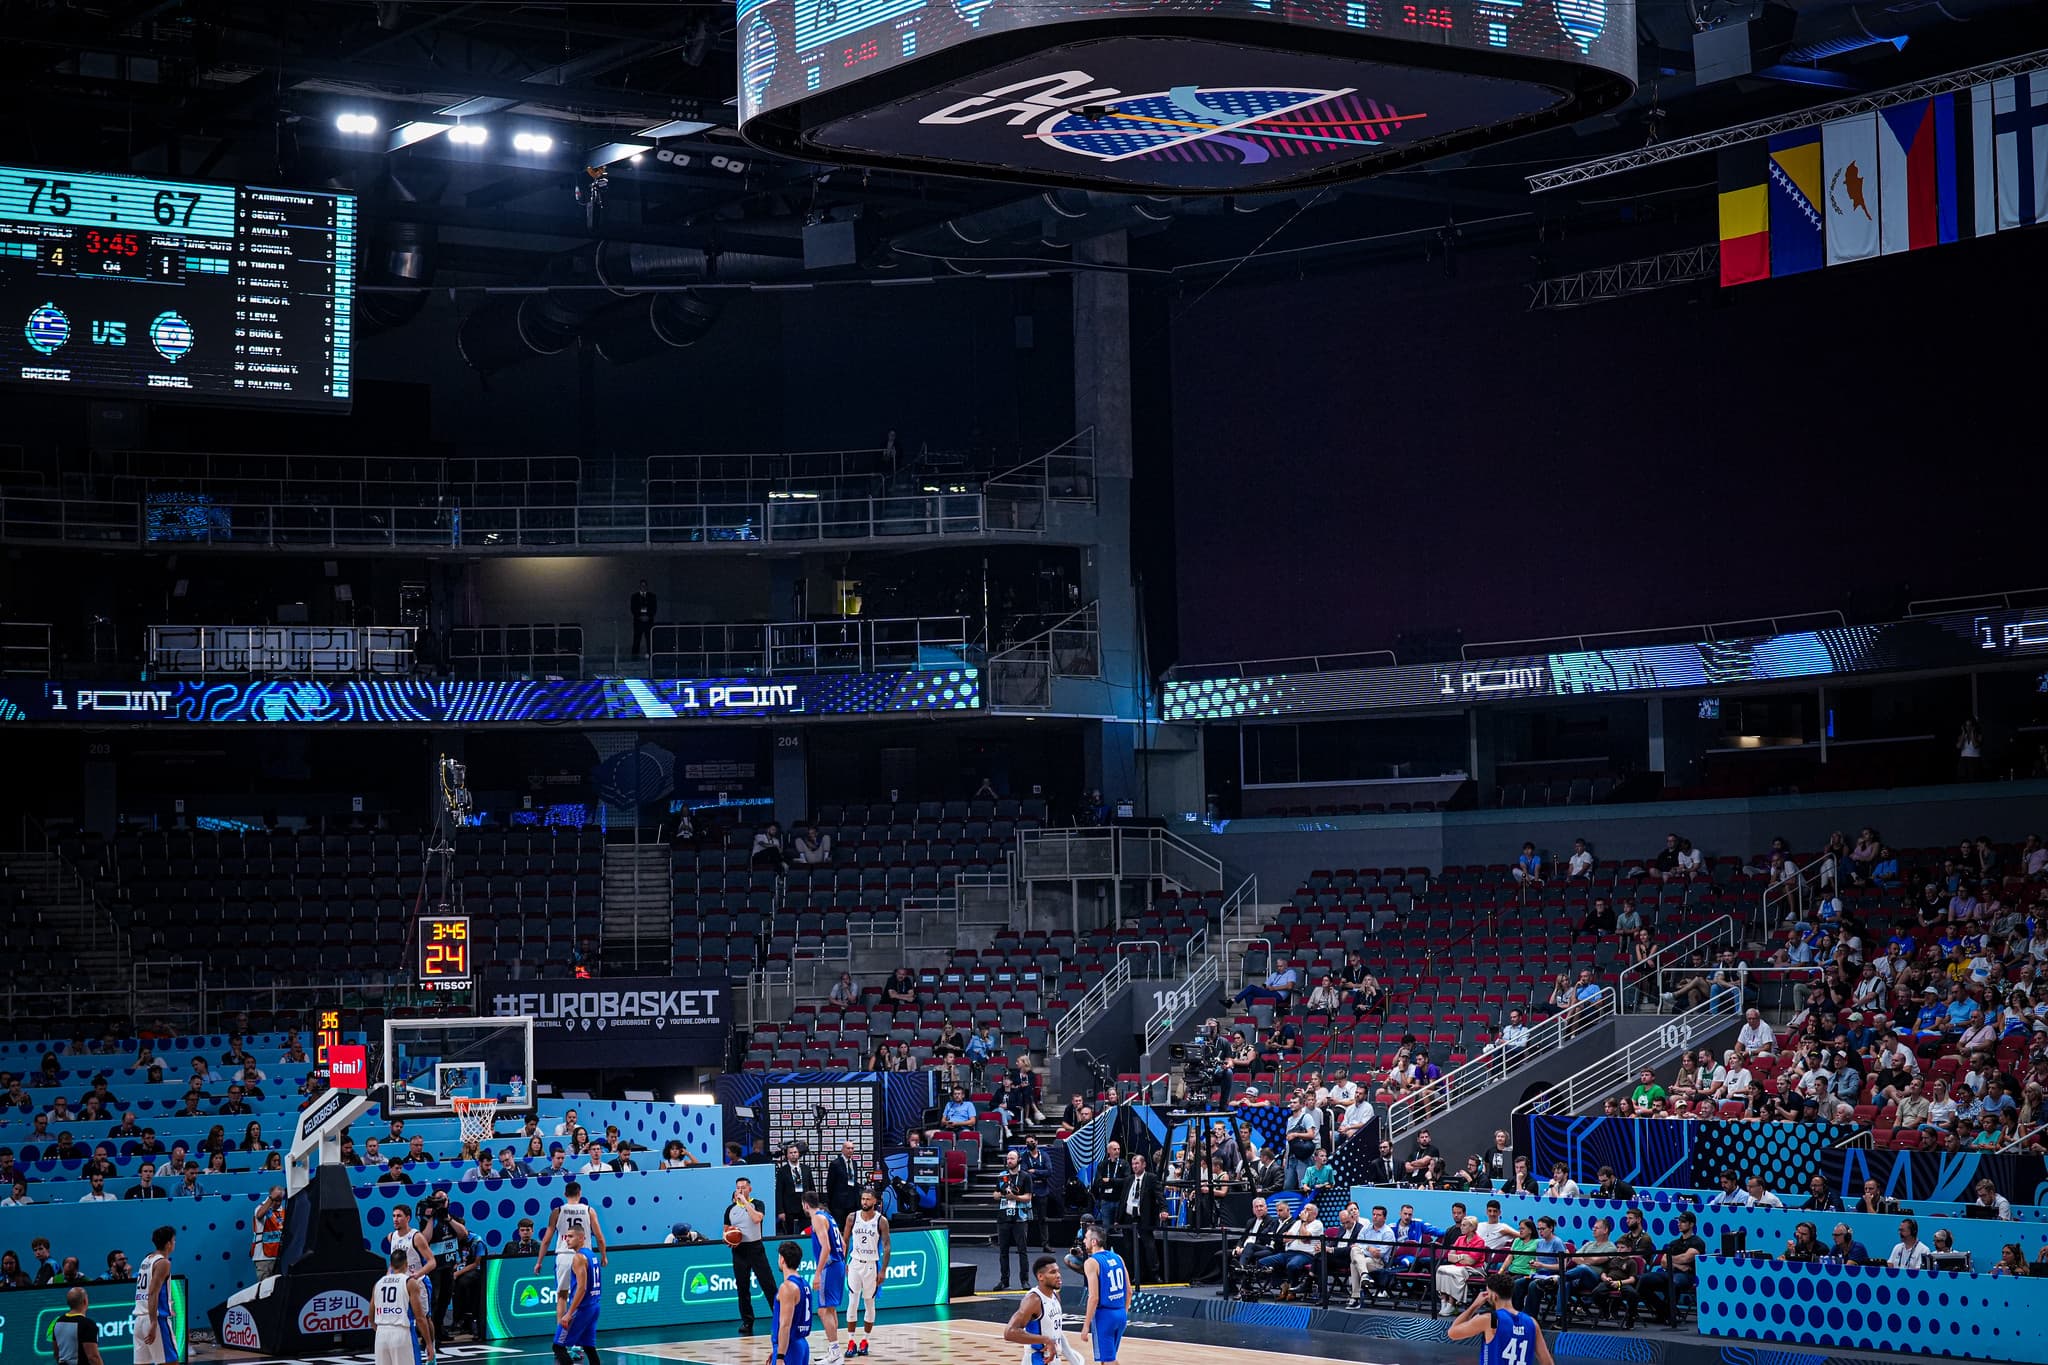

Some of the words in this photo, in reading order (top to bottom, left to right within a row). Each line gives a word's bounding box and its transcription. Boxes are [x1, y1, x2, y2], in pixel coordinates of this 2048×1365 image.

[24, 177, 72, 217] 75
[153, 190, 201, 228] 67
[86, 231, 139, 257] 3:45
[51, 247, 64, 266] 4
[160, 256, 169, 274] 1
[92, 320, 127, 346] VS
[22, 367, 71, 381] GREECE
[148, 375, 193, 389] ISRAEL
[1981, 625, 1996, 648] 1
[1440, 674, 1455, 694] 1
[1462, 668, 1544, 692] POINT
[52, 690, 68, 710] 1
[77, 691, 172, 711] POINT
[684, 687, 700, 707] 1
[709, 685, 797, 707] POINT
[778, 737, 798, 747] 204
[433, 923, 466, 941] 3:45
[426, 944, 463, 974] 24
[434, 981, 472, 990] TISSOT
[493, 990, 720, 1018] #EUROBASKET
[333, 1060, 356, 1074] Rimi
[861, 1236, 868, 1244] 2
[614, 1271, 661, 1284] PREPAID
[1107, 1267, 1124, 1292] 10
[313, 1296, 359, 1312] 百岁山
[381, 1286, 397, 1303] 10
[616, 1285, 660, 1304] eSIM
[1502, 1338, 1528, 1365] 41
